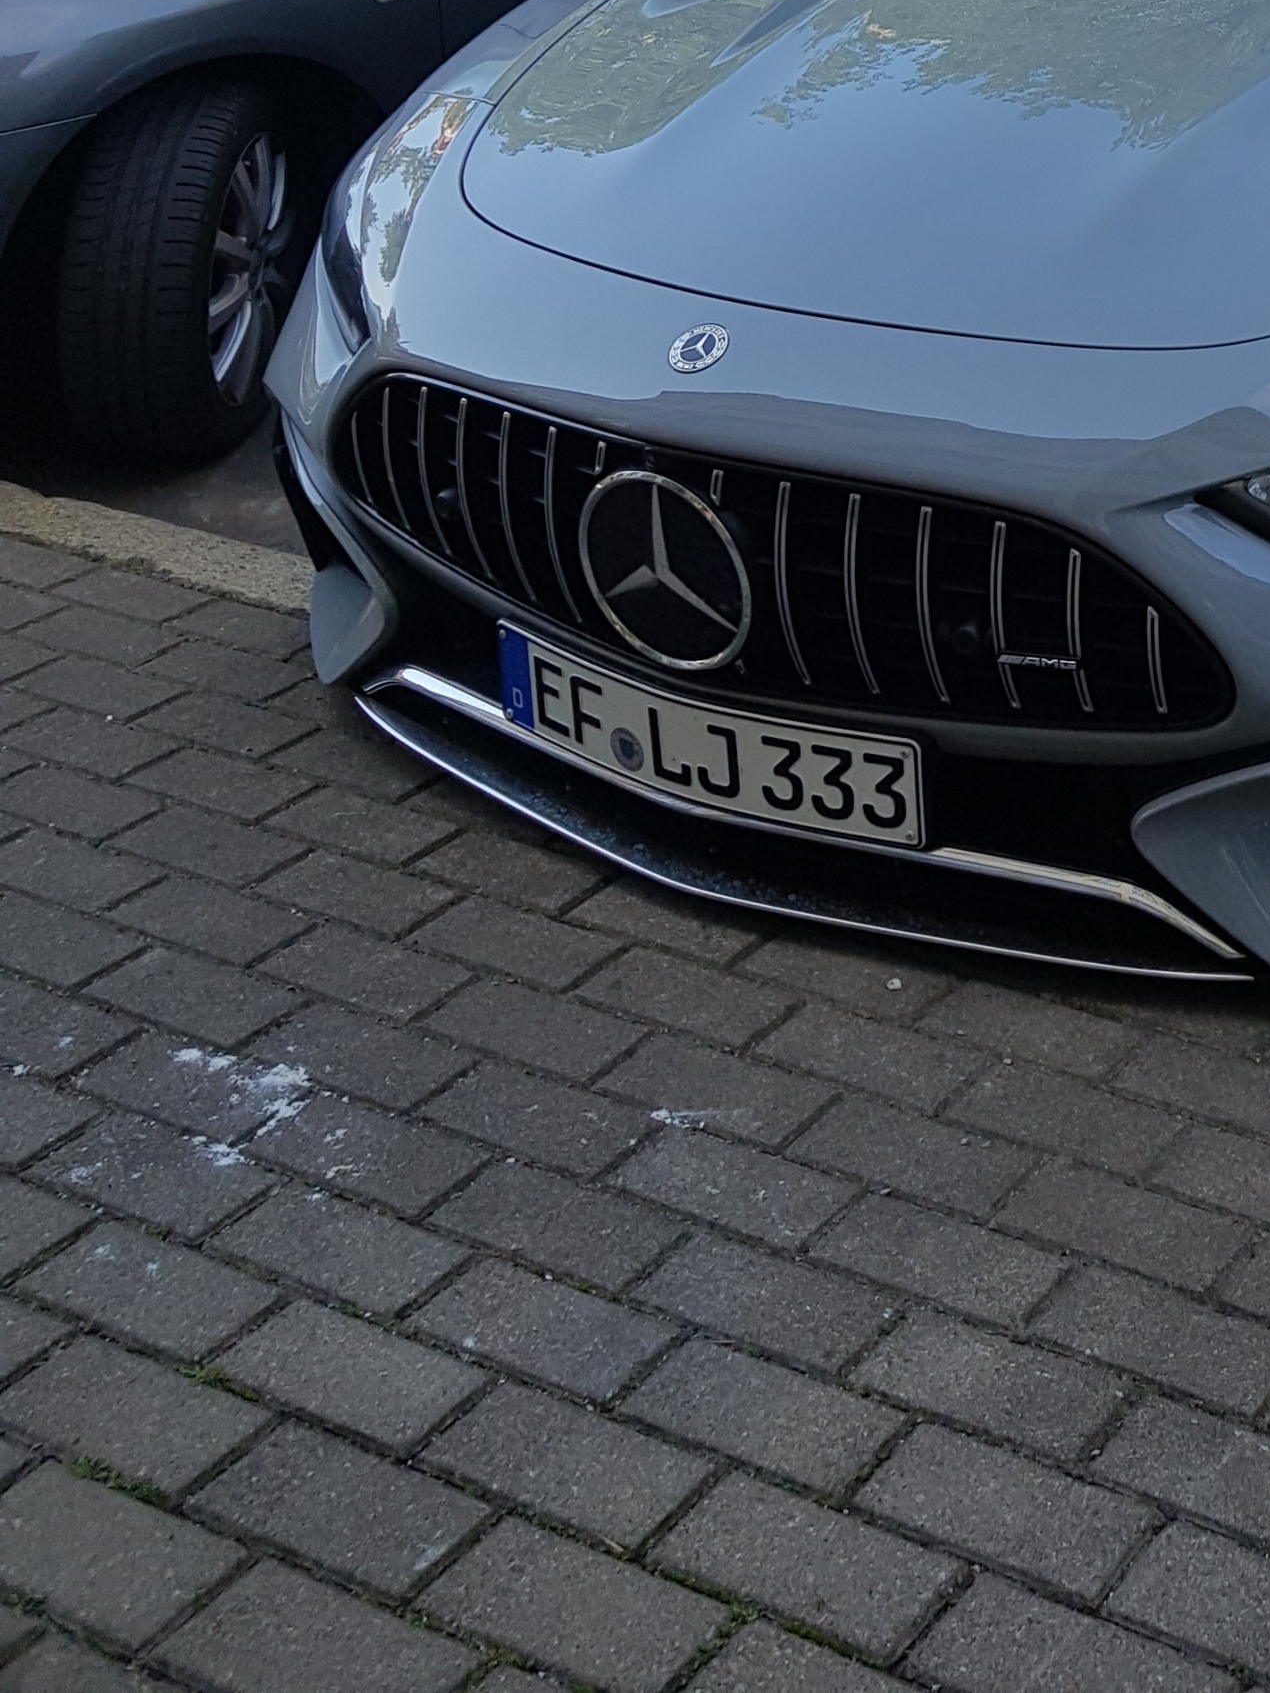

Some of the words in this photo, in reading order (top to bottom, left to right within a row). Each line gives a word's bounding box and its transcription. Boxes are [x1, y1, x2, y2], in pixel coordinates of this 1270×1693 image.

[512, 685, 524, 709] D
[533, 655, 603, 744] EF
[647, 706, 741, 799] LJ
[761, 734, 908, 829] 333
